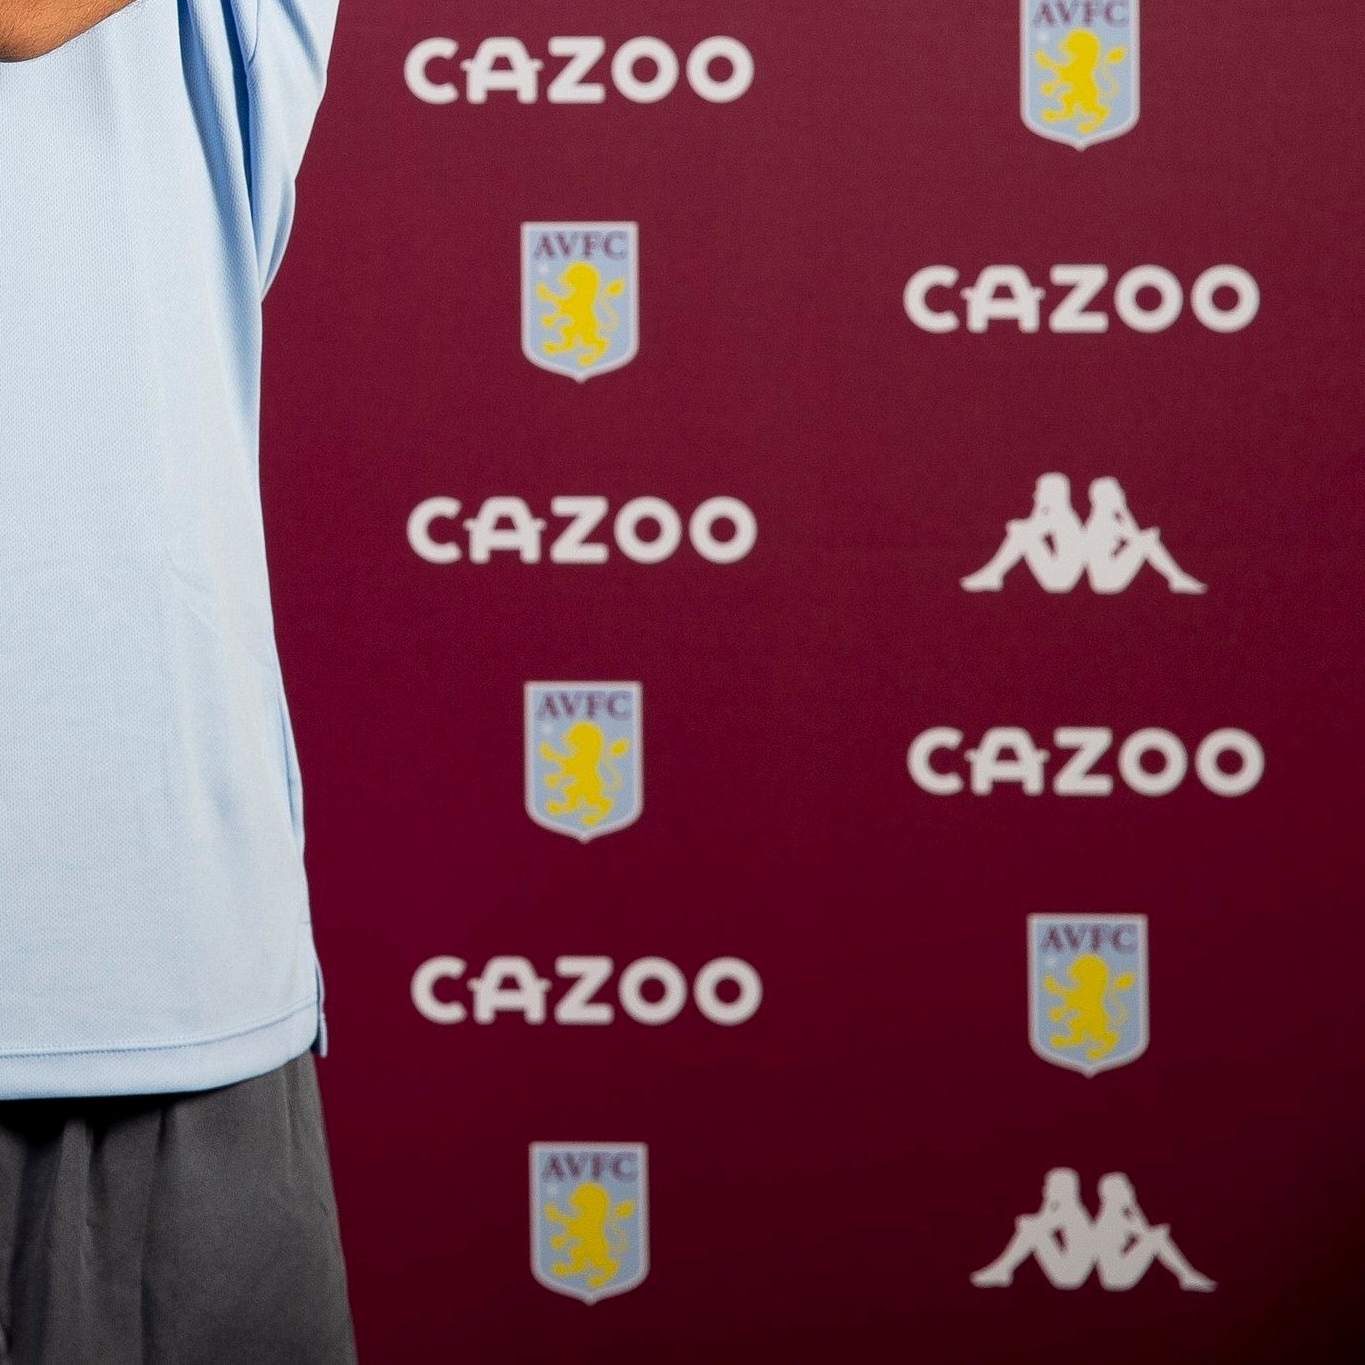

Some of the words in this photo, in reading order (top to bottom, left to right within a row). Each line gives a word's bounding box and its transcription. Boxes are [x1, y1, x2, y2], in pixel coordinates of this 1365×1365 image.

[404, 35, 754, 104] CAZOO
[534, 231, 628, 261] AVFC
[904, 264, 1260, 333] CAZOO
[407, 496, 757, 564] CAZOO
[538, 691, 632, 720] AVFC
[908, 727, 1264, 795] CAZOO
[1042, 924, 1137, 954] AVFC
[412, 957, 761, 1023] CAZOO
[544, 1152, 639, 1182] AVFC
